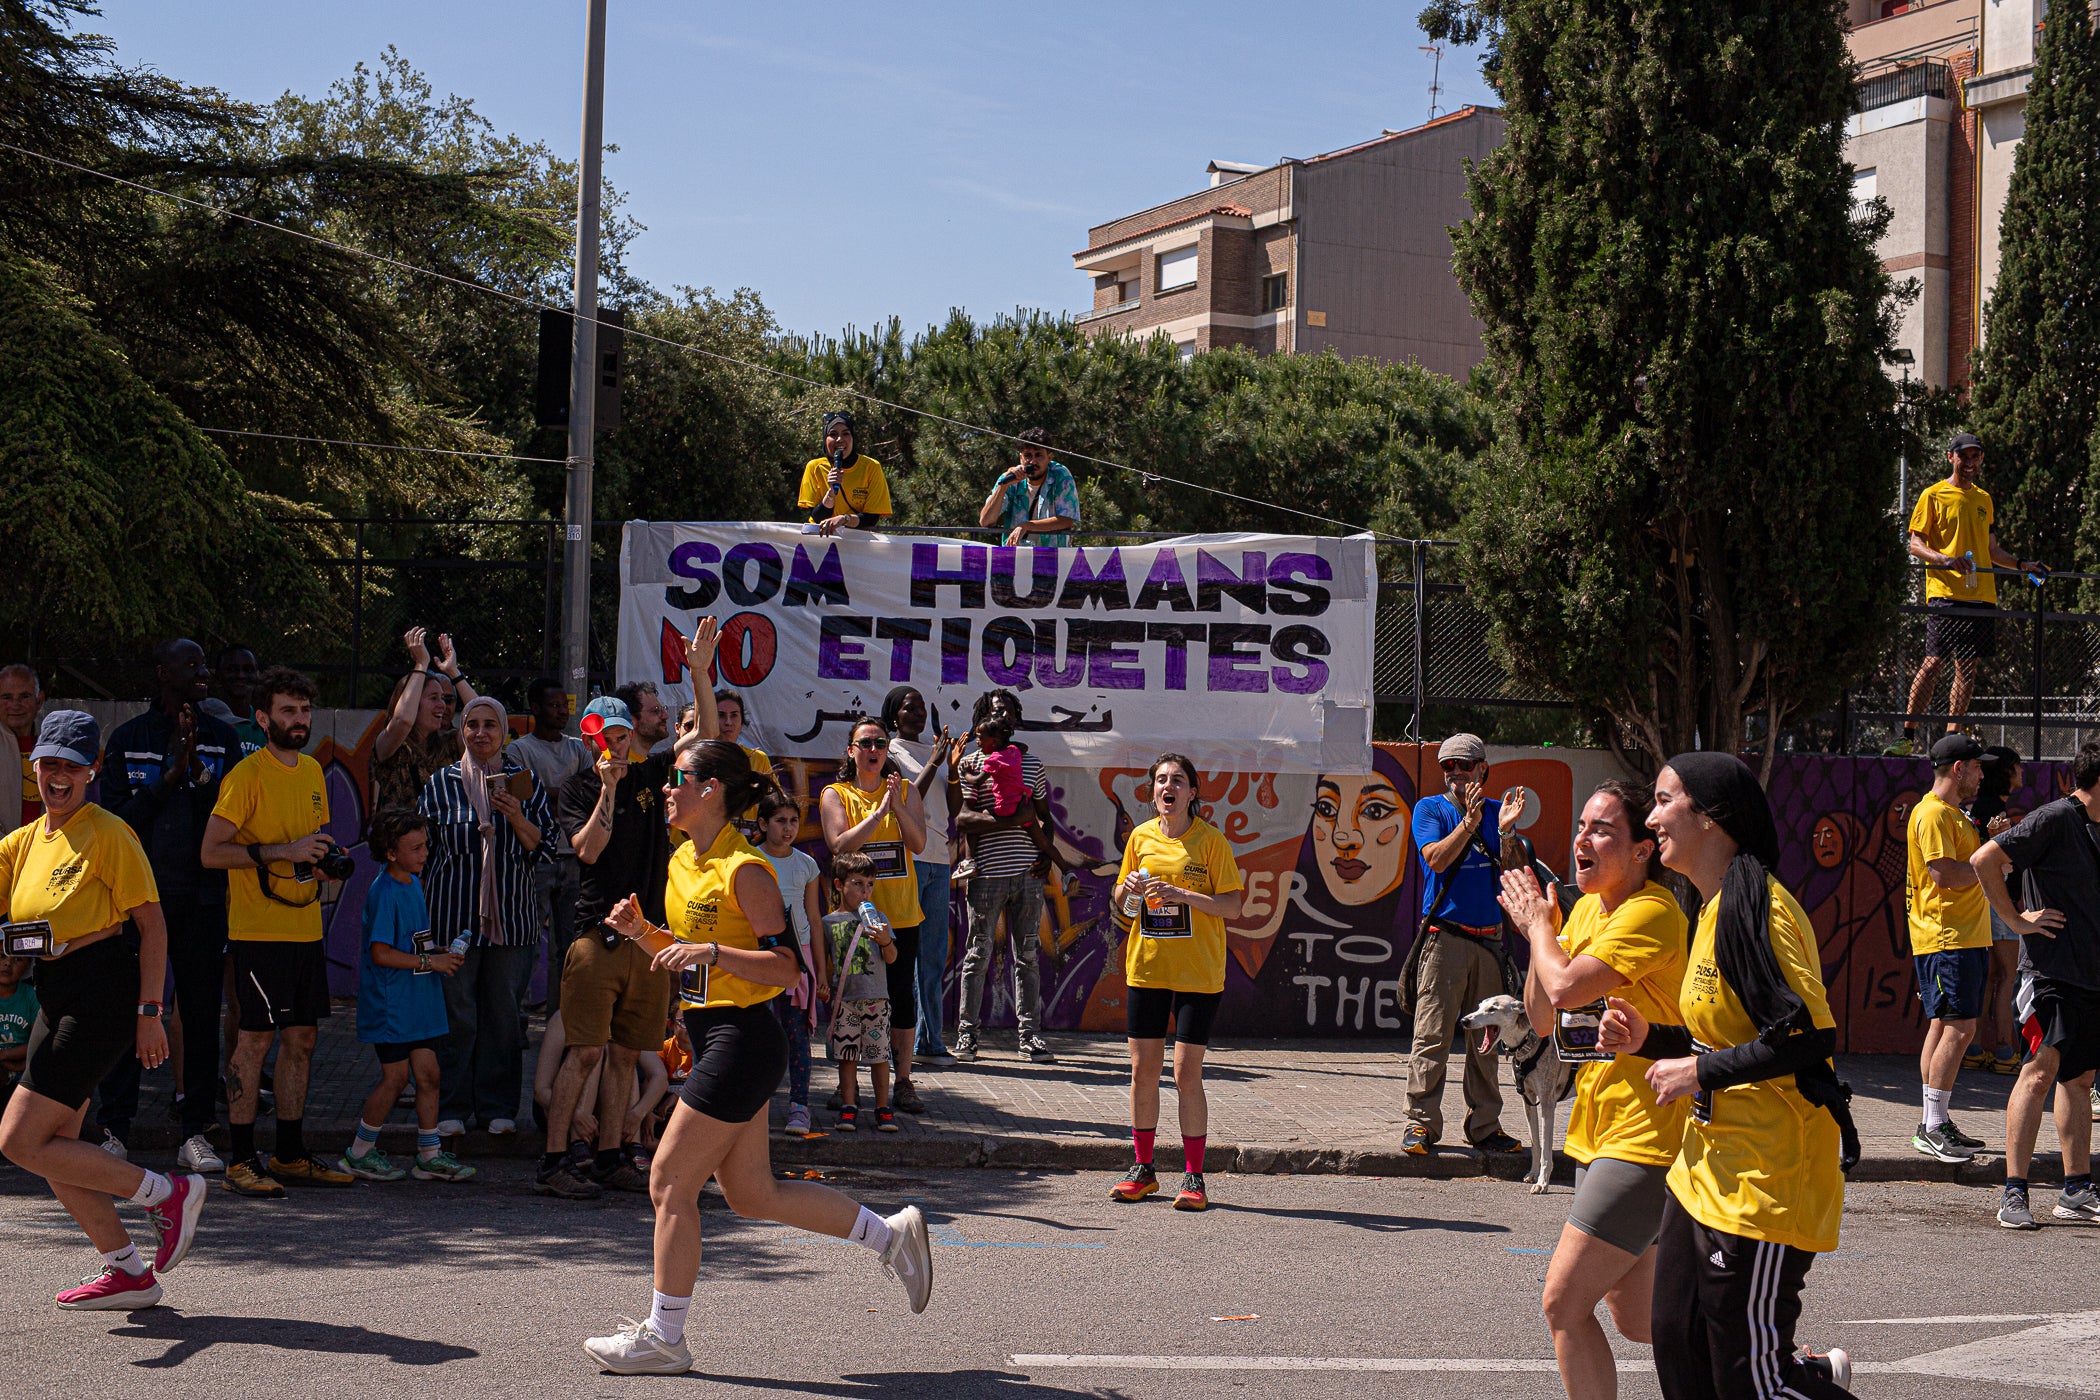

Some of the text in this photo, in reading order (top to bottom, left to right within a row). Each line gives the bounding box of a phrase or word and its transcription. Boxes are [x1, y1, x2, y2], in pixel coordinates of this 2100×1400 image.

[665, 541, 1333, 617] SOM HUMANS
[660, 611, 1332, 695] NO ETIQUETES
[1184, 865, 1208, 875] CURSA
[687, 900, 718, 913] CURSA
[1288, 932, 1393, 964] TO
[1292, 975, 1400, 1030] THE
